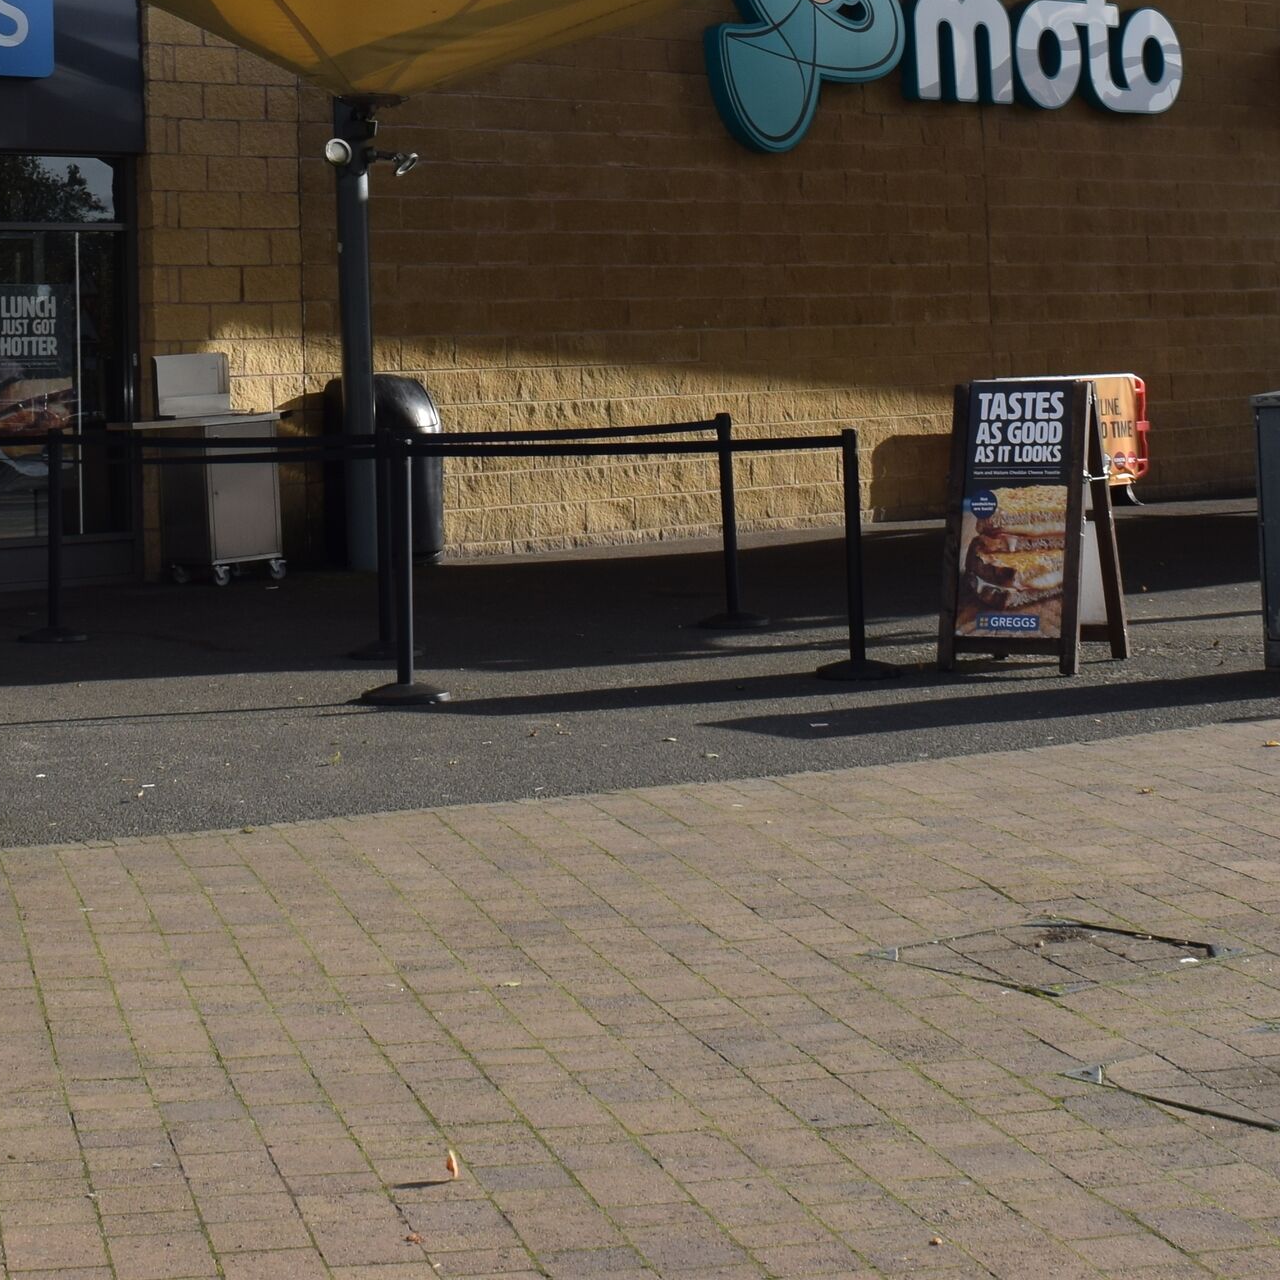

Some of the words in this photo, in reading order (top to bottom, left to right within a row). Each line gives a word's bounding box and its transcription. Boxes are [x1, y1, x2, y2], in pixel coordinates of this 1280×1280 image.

[0, 296, 57, 318] LUNCH
[1, 319, 28, 335] JUST
[32, 319, 55, 335] GOT
[0, 337, 58, 356] HOTTER
[978, 391, 1065, 420] TASTES
[975, 422, 1002, 445] AS
[1007, 421, 1063, 444] GOOD
[1110, 421, 1133, 438] TIME
[974, 446, 995, 463] AS
[997, 445, 1012, 463] IT
[1014, 445, 1062, 463] LOOKS
[990, 617, 1036, 628] GREGGS
